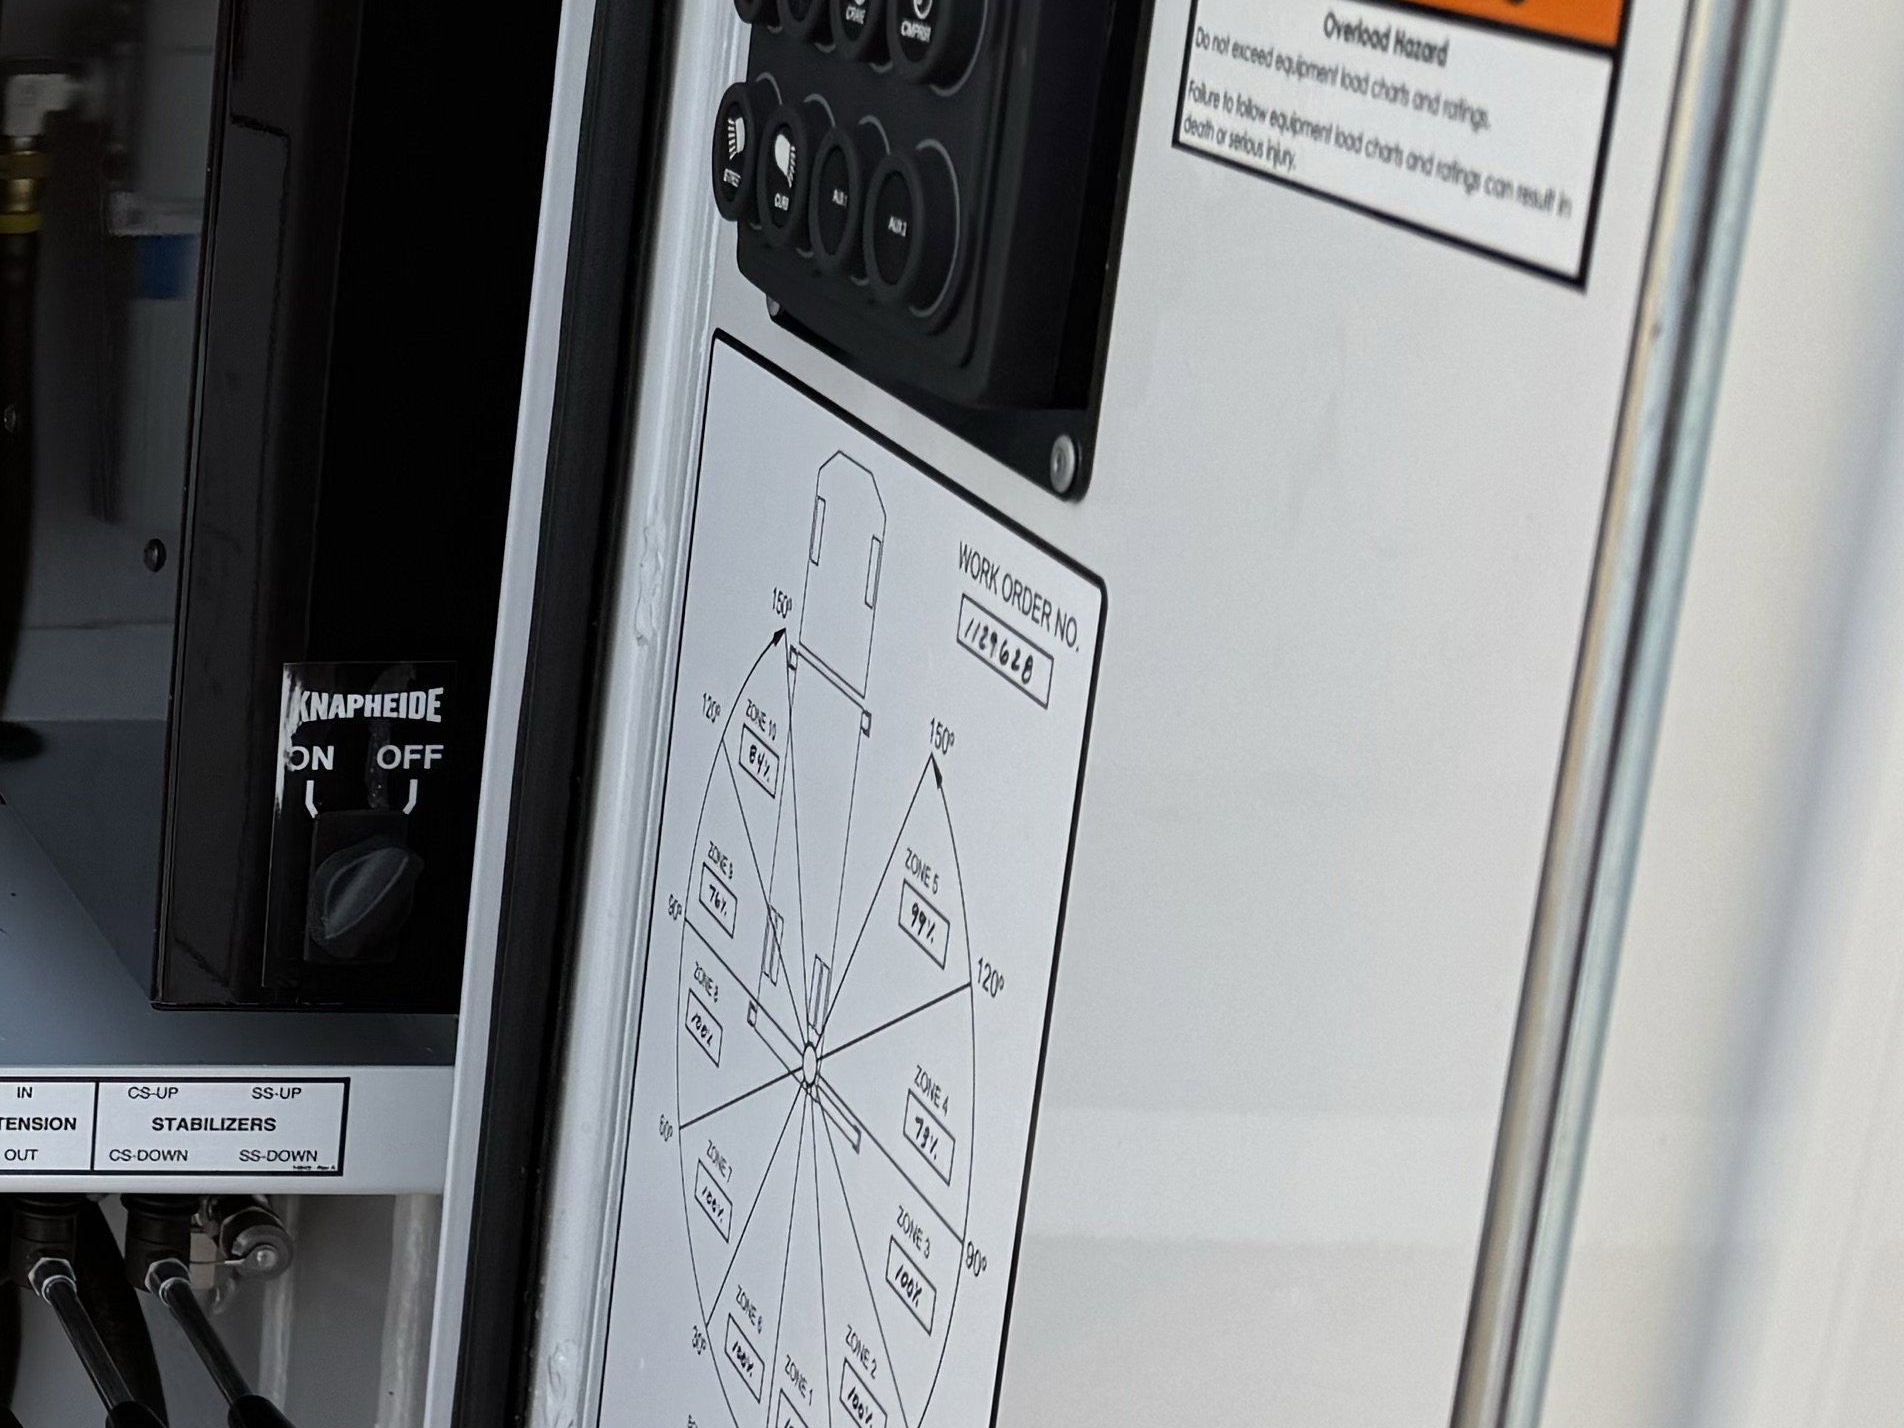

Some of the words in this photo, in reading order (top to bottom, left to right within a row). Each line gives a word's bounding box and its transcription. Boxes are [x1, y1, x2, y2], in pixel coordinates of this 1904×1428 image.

[846, 6, 866, 24] CRANE
[1323, 11, 1390, 53] Overload
[1395, 26, 1450, 68] Hazard
[1194, 26, 1209, 50] Do
[1212, 30, 1229, 56] not
[1232, 35, 1272, 67] exceed
[1276, 46, 1338, 87] equipment
[1340, 63, 1368, 94] load
[1371, 71, 1410, 106] charts
[1412, 81, 1440, 115] and
[1443, 87, 1490, 133] ratings.
[1184, 115, 1214, 145] death
[1216, 124, 1228, 148] or
[1229, 130, 1264, 162] serious
[1266, 140, 1296, 172] injury.
[1188, 78, 1220, 113] Failure
[1222, 87, 1234, 116] to
[1236, 91, 1266, 123] follow
[1270, 104, 1332, 144] equipment
[1335, 121, 1362, 156] load
[1366, 130, 1404, 170] charts
[1407, 143, 1434, 177] and
[1436, 151, 1481, 195] ratings
[1484, 166, 1514, 201] can
[1517, 176, 1554, 215] result
[1558, 188, 1572, 218] in
[959, 541, 1000, 595] WORK
[1002, 573, 1052, 629] ORDER
[1055, 603, 1080, 652] NO.
[964, 618, 1034, 685] 1129628
[298, 687, 444, 723] KNAPHEIDE
[746, 698, 766, 730] ZONE
[767, 719, 776, 741] 10
[929, 718, 955, 755] 150°
[290, 745, 335, 771] ON
[376, 744, 444, 770] OFF
[749, 744, 770, 783] 84%
[904, 847, 931, 888] ZONE
[932, 874, 939, 895] 5
[708, 884, 728, 918] 76%
[911, 903, 935, 944] 99%
[16, 1086, 33, 1099] IN
[127, 1086, 179, 1100] CS-UP
[251, 1086, 302, 1100] SS-UP
[913, 1064, 940, 1109] ZONE
[943, 1095, 949, 1117] 4
[151, 1117, 277, 1132] STABILIZERS
[4, 1148, 38, 1162] OUT
[109, 1148, 189, 1163] CS-DOWN
[239, 1149, 318, 1163] SS-DOWN
[707, 1140, 726, 1176] ZONE
[726, 1166, 733, 1184] 7
[702, 1186, 724, 1222] 100%
[897, 1204, 923, 1252] ZONE
[924, 1238, 930, 1260] 3
[736, 1284, 756, 1326] ZONE
[895, 1264, 922, 1308] 100%
[732, 1340, 754, 1378] 100%
[845, 1324, 870, 1371] ZONE
[871, 1358, 878, 1380] 2
[784, 1354, 807, 1399] ZONE
[808, 1388, 814, 1406] 1
